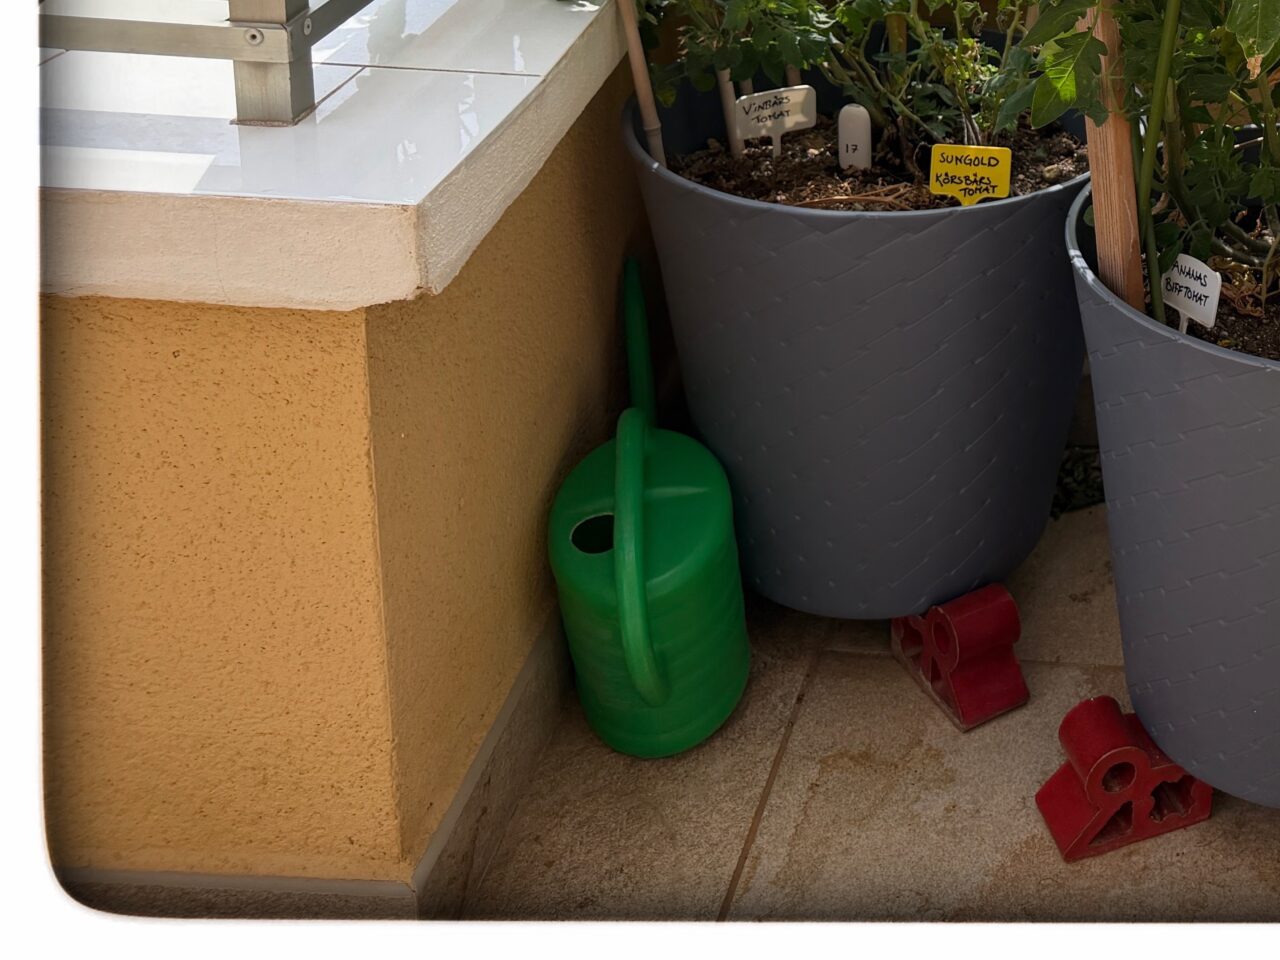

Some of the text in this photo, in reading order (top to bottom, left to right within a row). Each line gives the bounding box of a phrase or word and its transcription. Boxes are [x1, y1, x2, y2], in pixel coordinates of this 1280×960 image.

[845, 143, 858, 154] 17
[939, 152, 1000, 167] SUNGOLD
[1171, 260, 1208, 287] ANANAS
